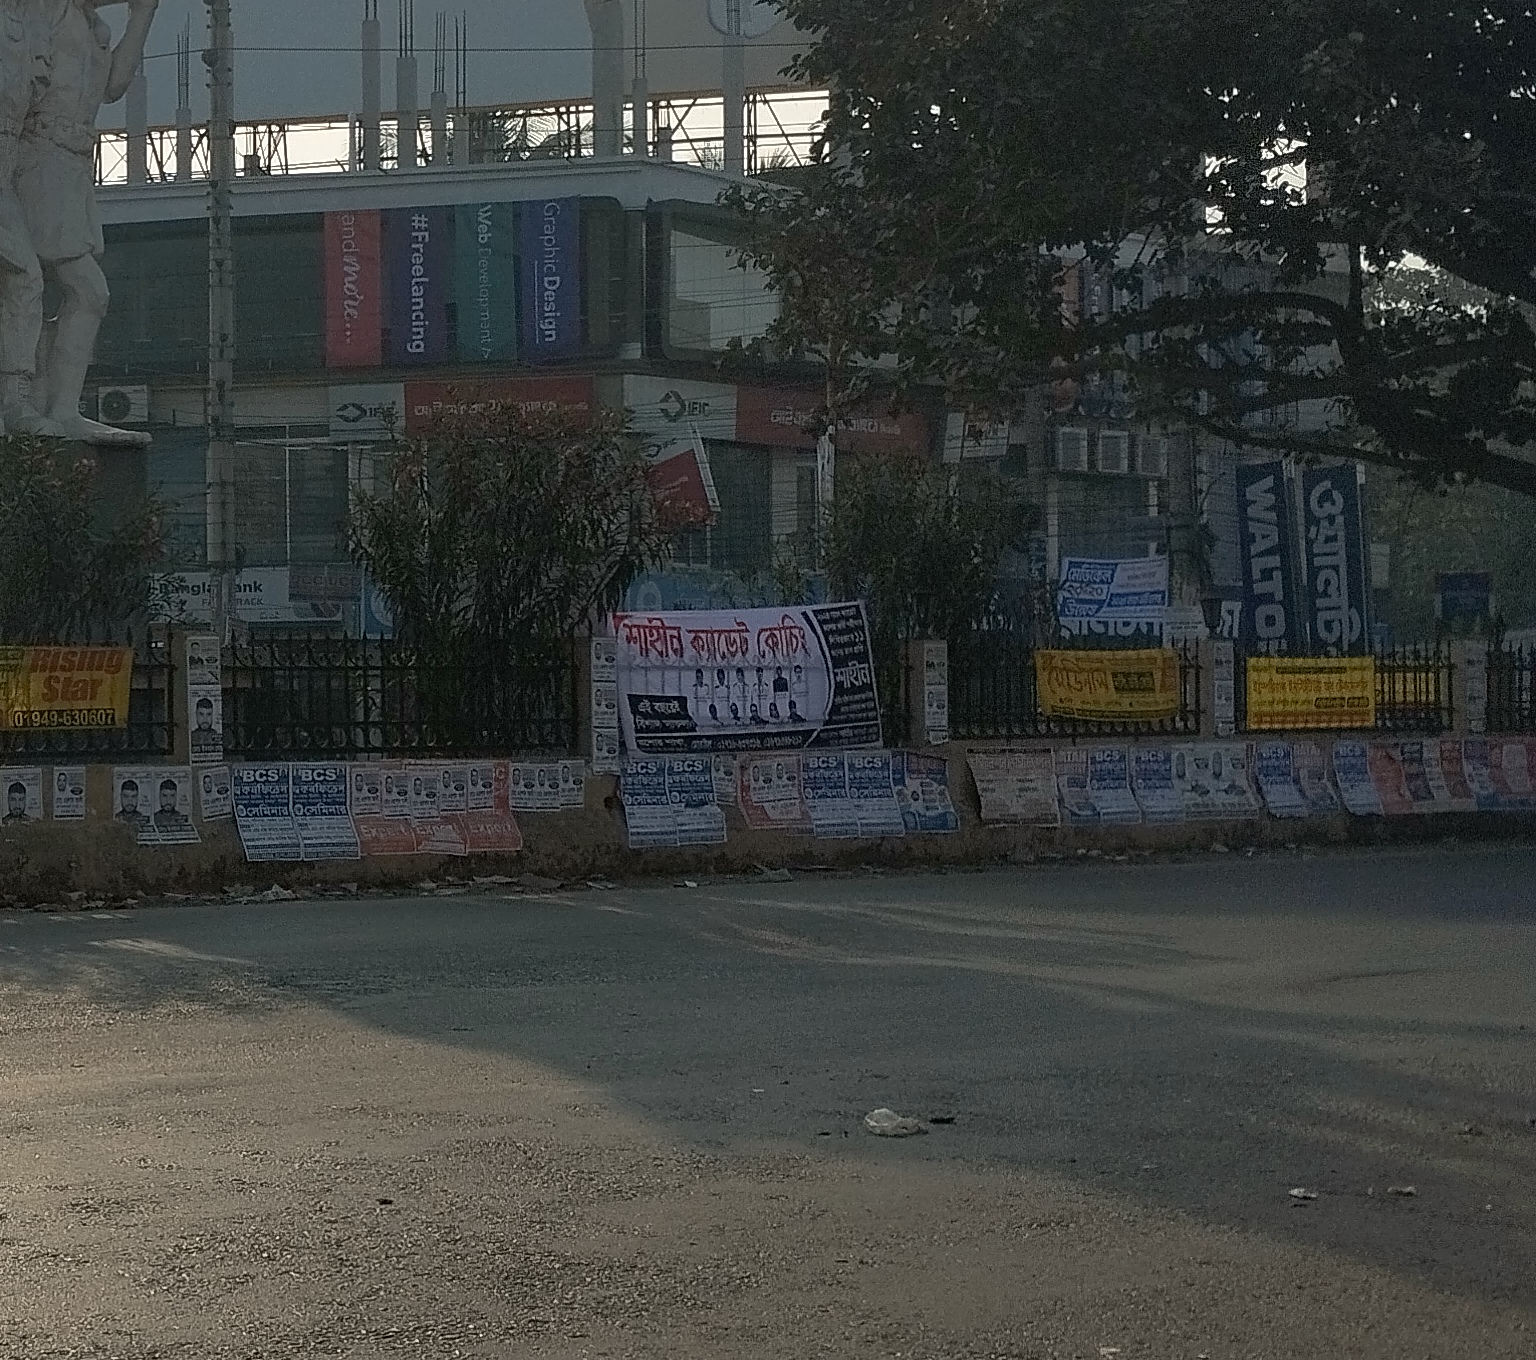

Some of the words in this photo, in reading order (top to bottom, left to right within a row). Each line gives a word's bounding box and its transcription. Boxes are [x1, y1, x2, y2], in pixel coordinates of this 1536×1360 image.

[477, 204, 493, 244] Web
[340, 214, 360, 252] and
[539, 201, 562, 273] Graphic
[406, 213, 430, 354] #Freelancing
[539, 275, 561, 342] Design
[235, 581, 263, 593] ank
[620, 617, 684, 659] শাহীন
[686, 617, 750, 662] ক্যাডেট
[757, 614, 811, 660] কোচিং
[30, 648, 125, 675] Rising
[834, 660, 871, 689] শাহীন
[41, 675, 103, 703] Star
[14, 710, 114, 727] 01949-630607
[627, 762, 657, 774] BCS
[673, 760, 704, 772] BCS
[809, 756, 838, 768] BCS
[854, 757, 883, 768] BCS
[242, 769, 279, 782] BCS
[301, 768, 337, 782] BCS
[247, 803, 289, 816] সেমিনার
[304, 803, 347, 815] সেমিনার
